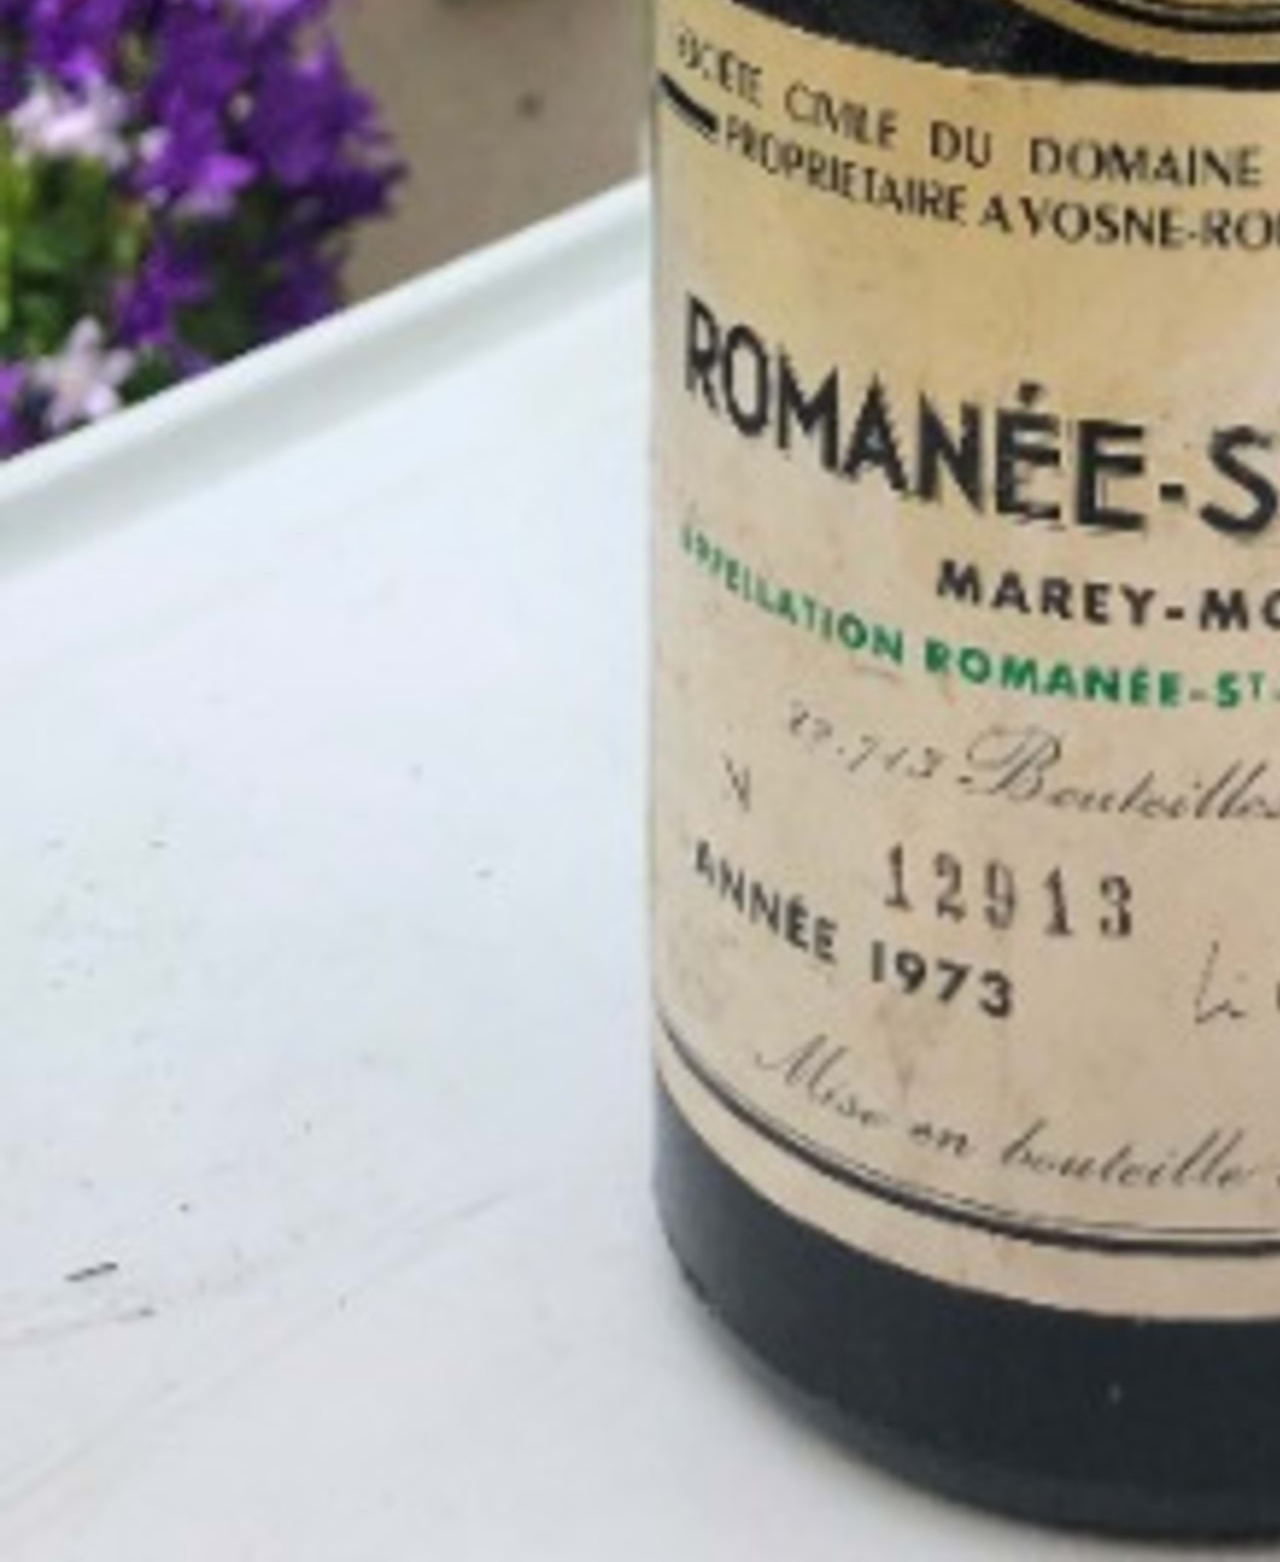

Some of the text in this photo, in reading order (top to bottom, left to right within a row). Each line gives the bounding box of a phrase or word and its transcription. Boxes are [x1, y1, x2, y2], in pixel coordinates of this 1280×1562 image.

[929, 119, 993, 169] DU
[1030, 137, 1262, 188] DOMAINE
[694, 838, 1015, 1020] ANNÉE 1973
[880, 841, 1136, 940] 12913
[1000, 1116, 1258, 1192] bouteille
